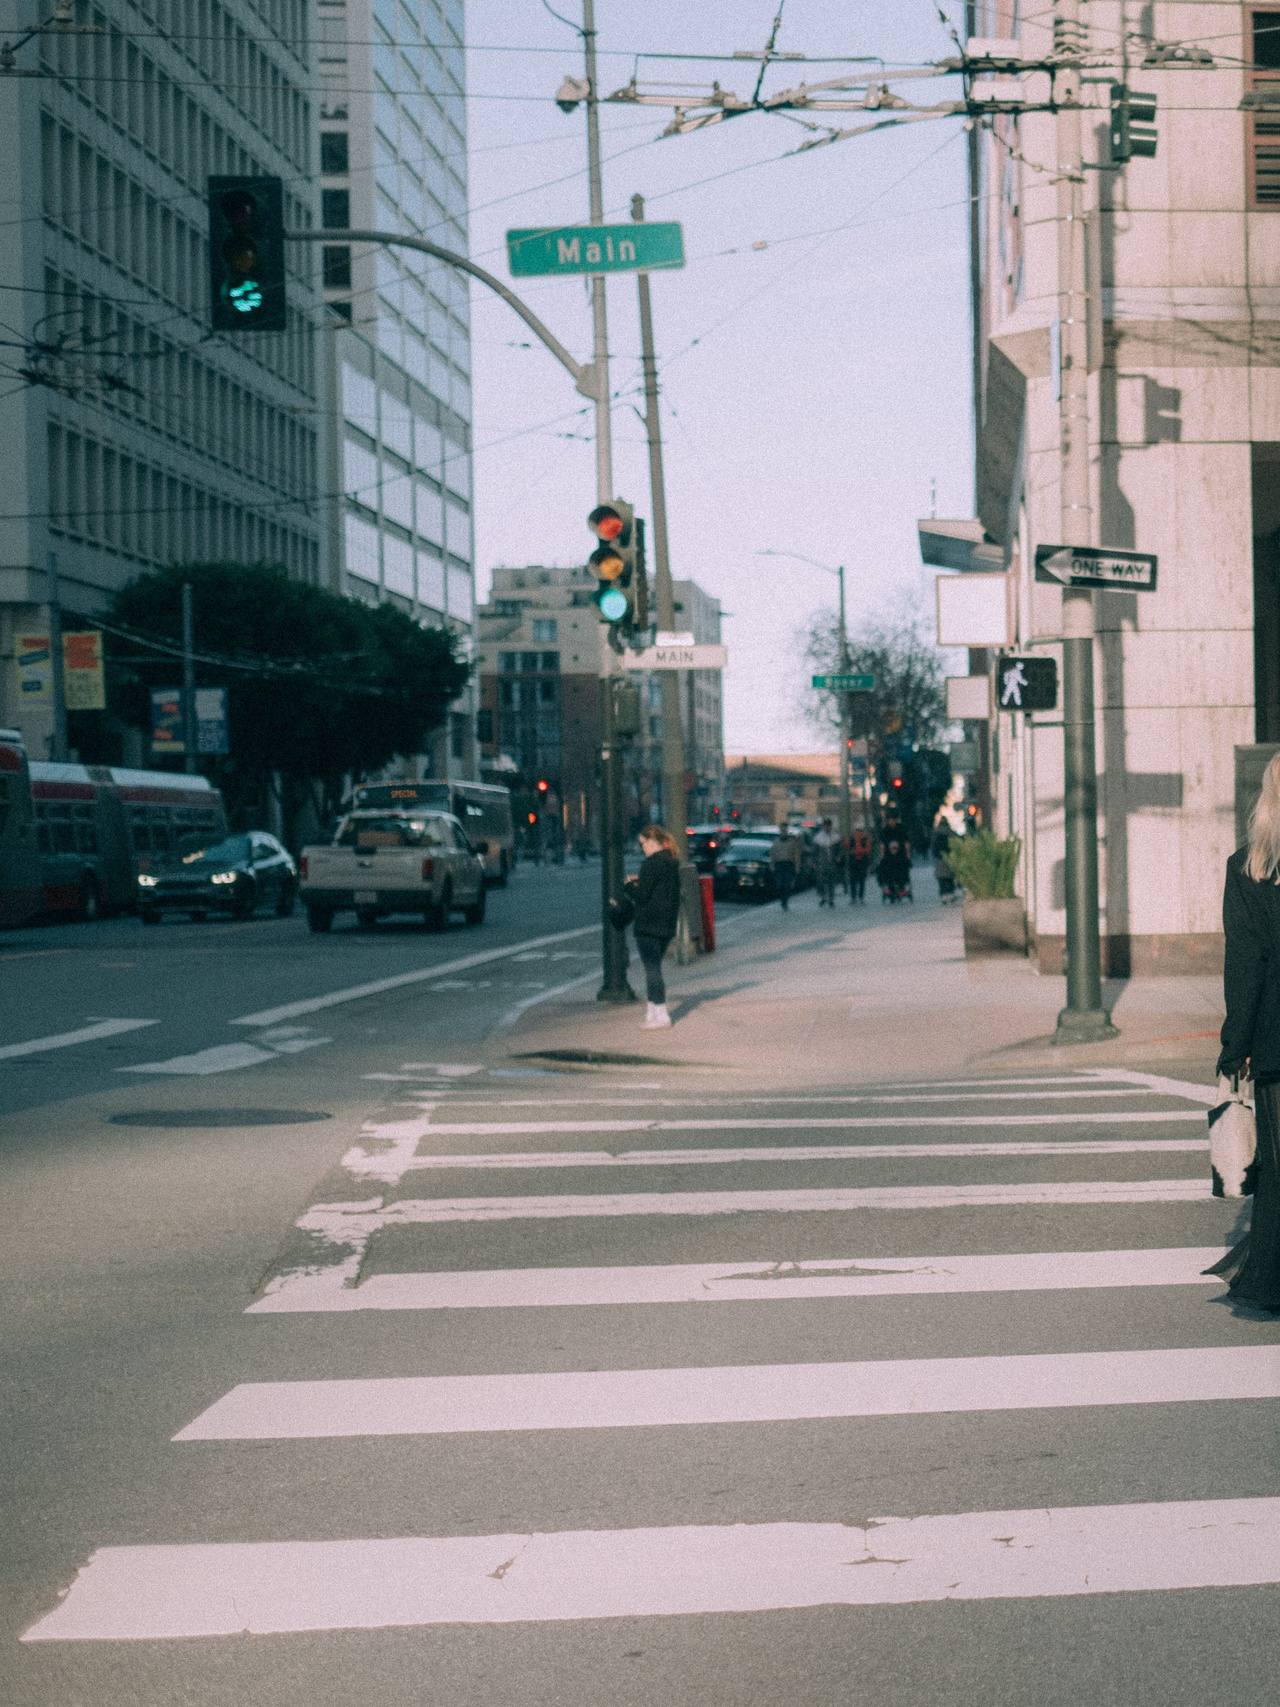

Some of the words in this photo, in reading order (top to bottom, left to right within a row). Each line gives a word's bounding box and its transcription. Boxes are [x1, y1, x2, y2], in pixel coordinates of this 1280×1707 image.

[557, 235, 636, 264] Main
[1071, 559, 1104, 577] ONE
[1111, 562, 1145, 578] WAY
[656, 651, 694, 662] MAIN
